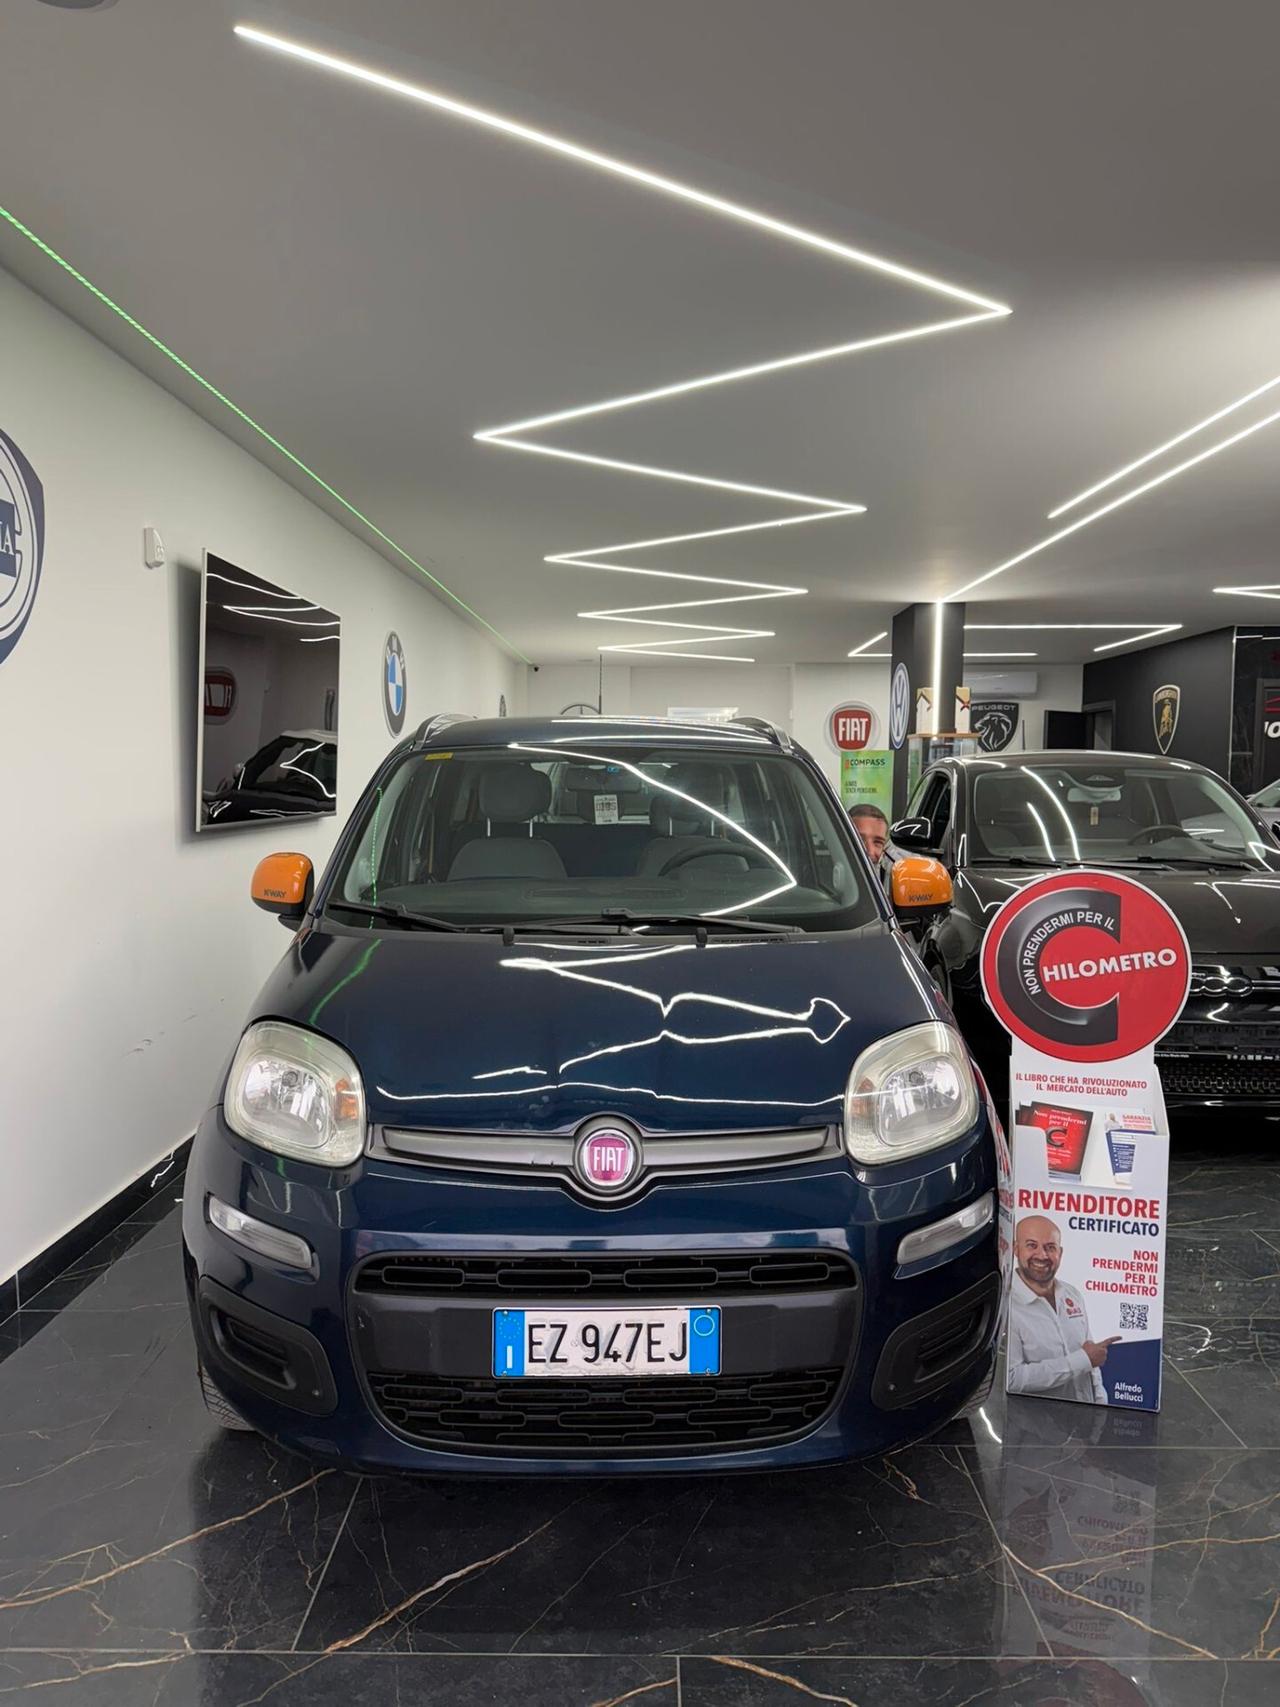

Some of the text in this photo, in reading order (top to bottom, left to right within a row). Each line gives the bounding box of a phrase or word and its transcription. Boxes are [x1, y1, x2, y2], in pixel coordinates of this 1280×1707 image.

[971, 703, 1016, 712] PEUGEOT
[838, 717, 868, 742] FIAT
[850, 758, 886, 767] COMPASS
[1023, 911, 1114, 995] NON PRENDERMI PER IL
[1015, 1073, 1147, 1089] IL LIBRO CHE HA RIVOLUZIONATO
[1036, 1083, 1128, 1097] IL MERCATO DELL'AUTO
[593, 1146, 625, 1172] FIAT
[1018, 1188, 1160, 1219] RIVENDITORE
[1068, 1216, 1160, 1237] CERTIFICATO
[1133, 1249, 1159, 1262] NON
[1092, 1257, 1158, 1273] PRENDERMI
[1125, 1272, 1158, 1285] PER IL
[1085, 1280, 1158, 1297] CHILOMETRO
[528, 1322, 688, 1363] EZ 947EJ
[1114, 1382, 1142, 1393] Alfredo
[1114, 1391, 1143, 1403] Bellucci
